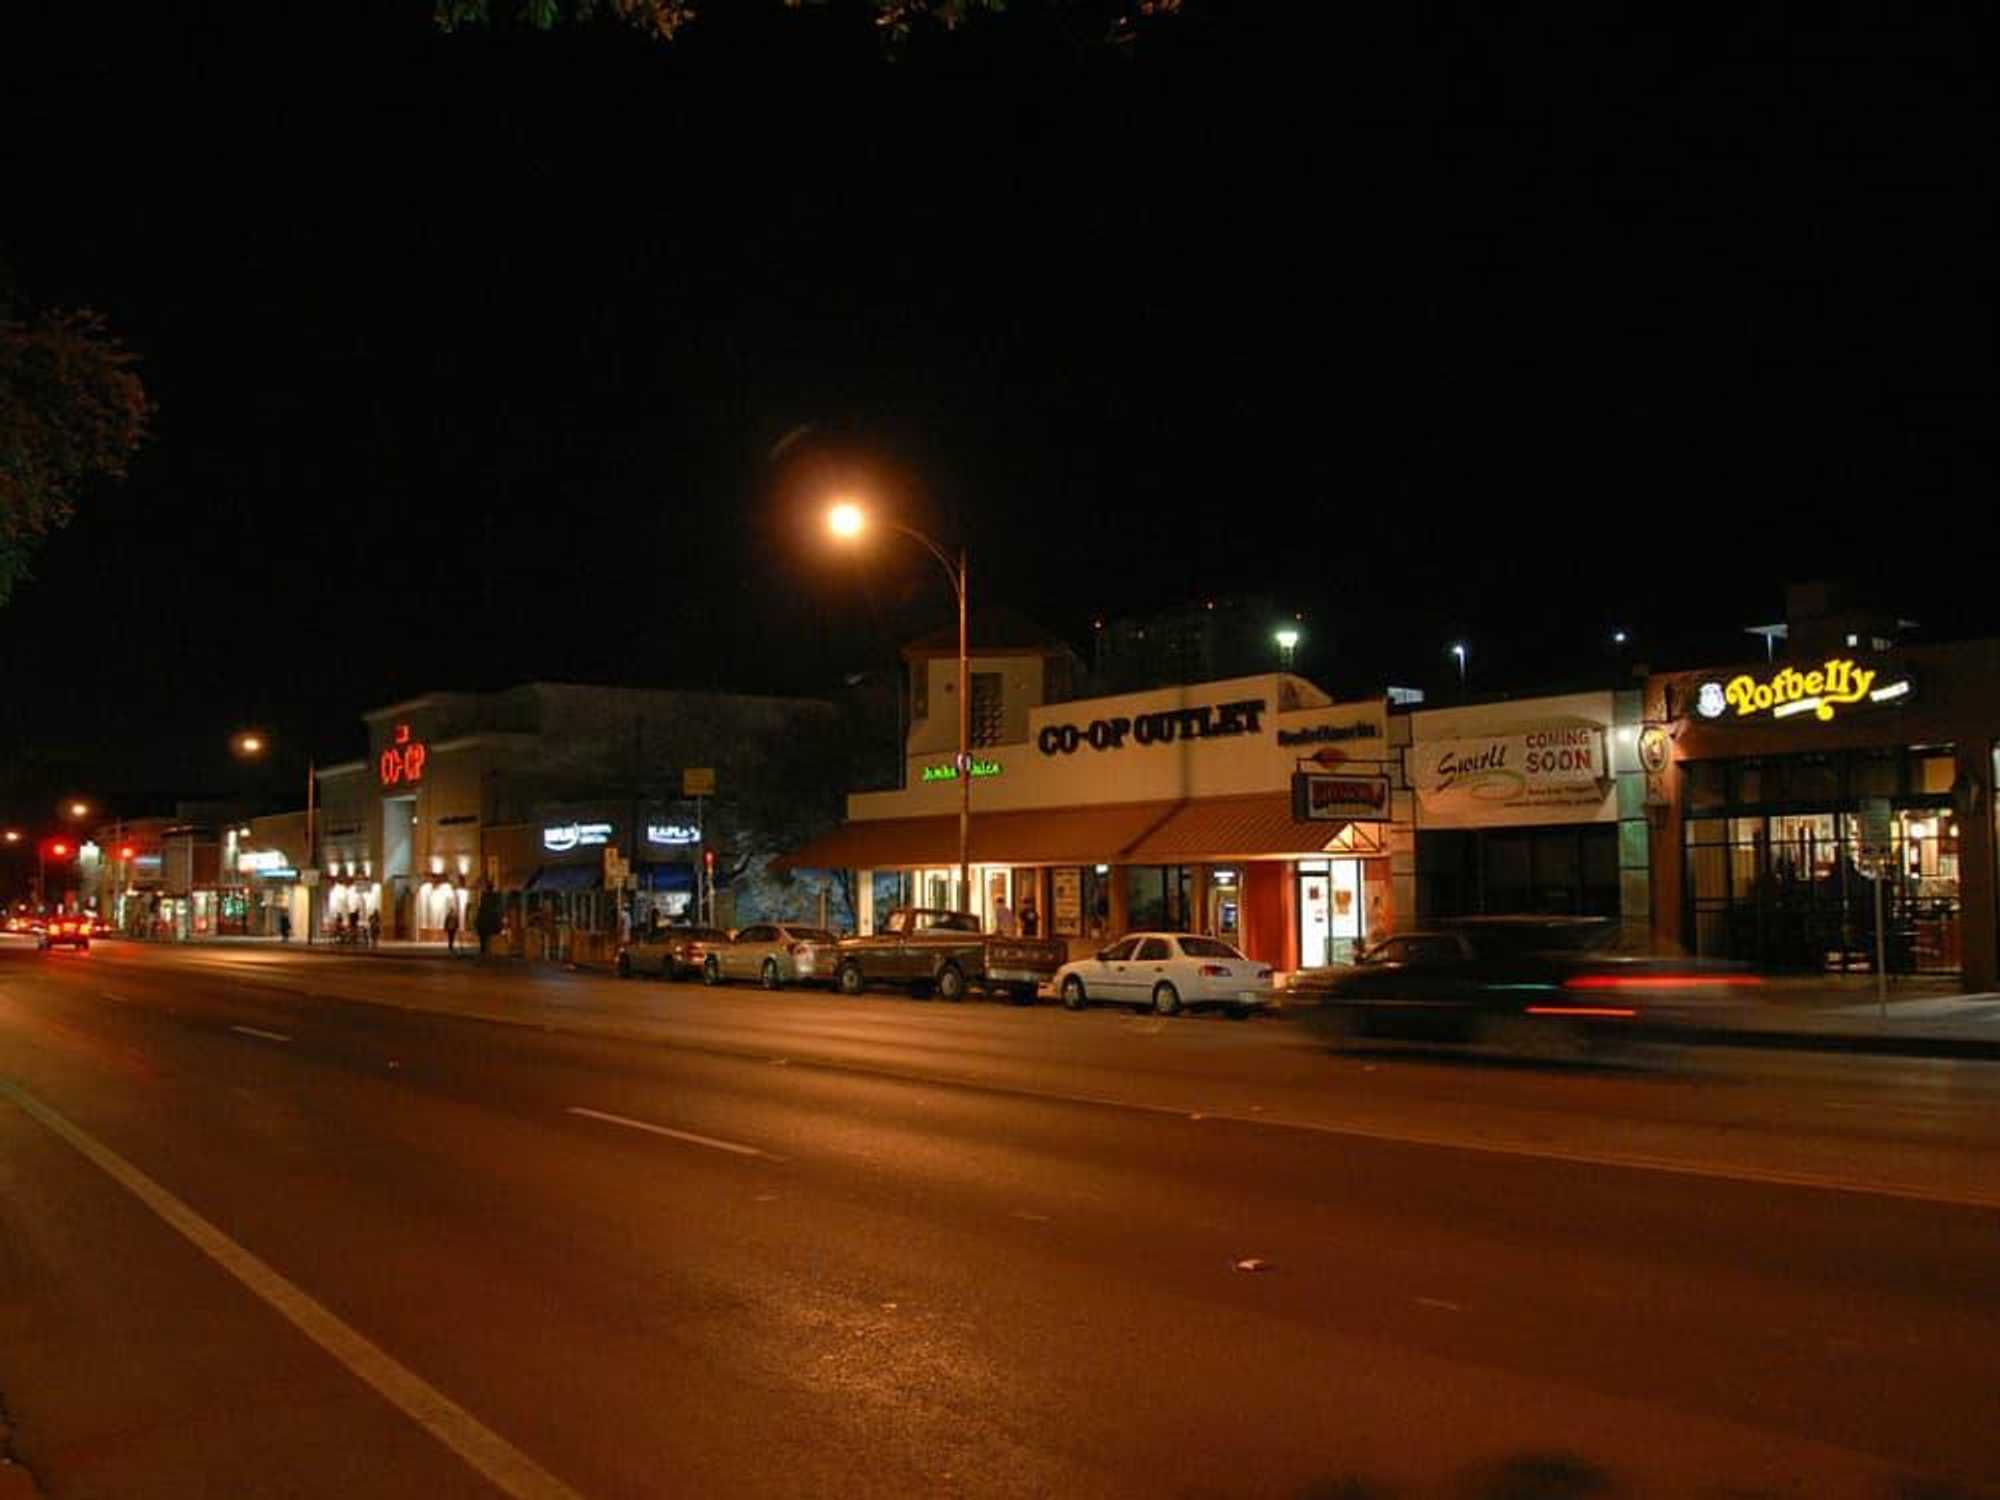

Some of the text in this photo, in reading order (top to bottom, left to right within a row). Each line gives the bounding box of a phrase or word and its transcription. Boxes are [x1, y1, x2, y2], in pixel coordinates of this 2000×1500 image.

[1726, 659, 1876, 722] Potbelly
[1038, 718, 1132, 757] CO-OP
[1133, 699, 1265, 746] OUTLET
[1526, 729, 1590, 749] COMING
[1526, 749, 1592, 774] SOON
